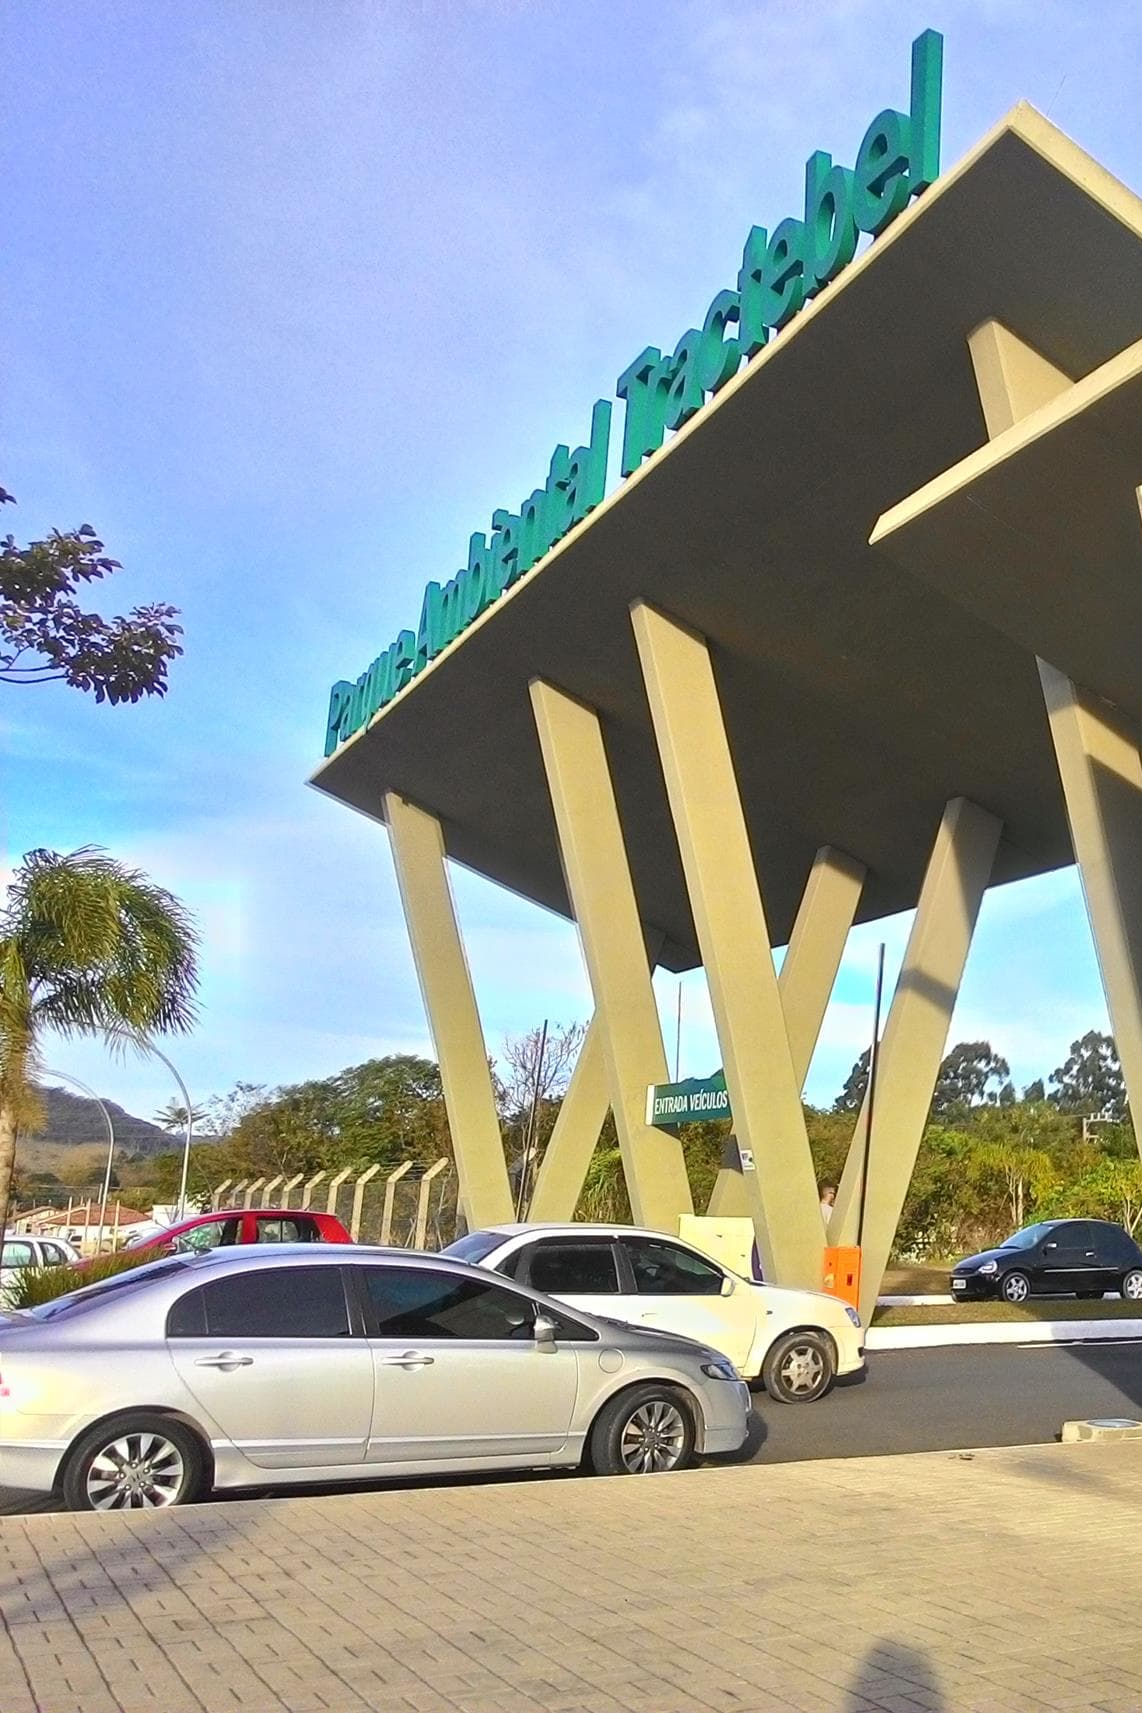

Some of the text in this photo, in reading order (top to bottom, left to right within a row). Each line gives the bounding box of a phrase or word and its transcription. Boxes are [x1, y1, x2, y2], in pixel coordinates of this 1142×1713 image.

[324, 28, 944, 757] Parque Ambiental Tractebel
[654, 1088, 728, 1115] ENTRADA VEÍCULOS
